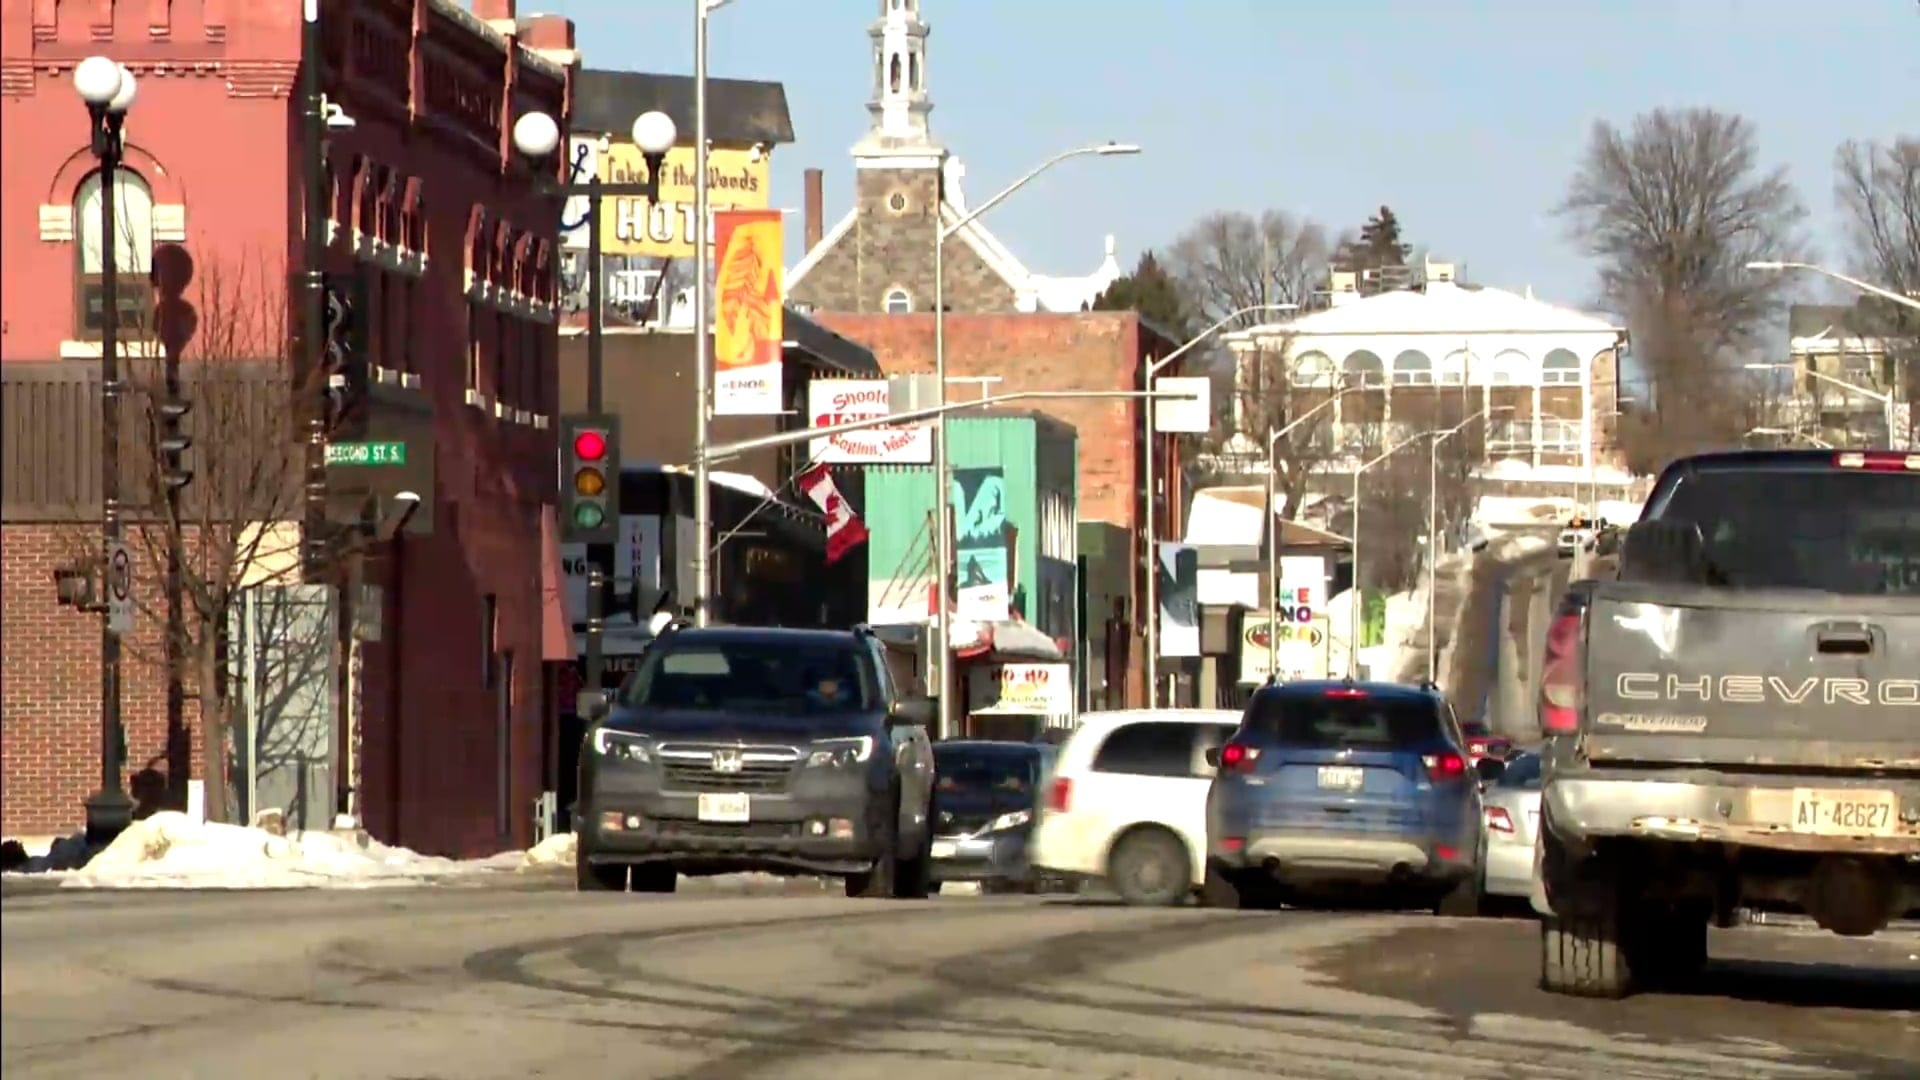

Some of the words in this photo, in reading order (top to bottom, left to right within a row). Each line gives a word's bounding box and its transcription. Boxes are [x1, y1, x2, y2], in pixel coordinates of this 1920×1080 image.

[706, 166, 758, 192] Woods
[616, 197, 715, 244] HOT
[1280, 606, 1312, 622] NO
